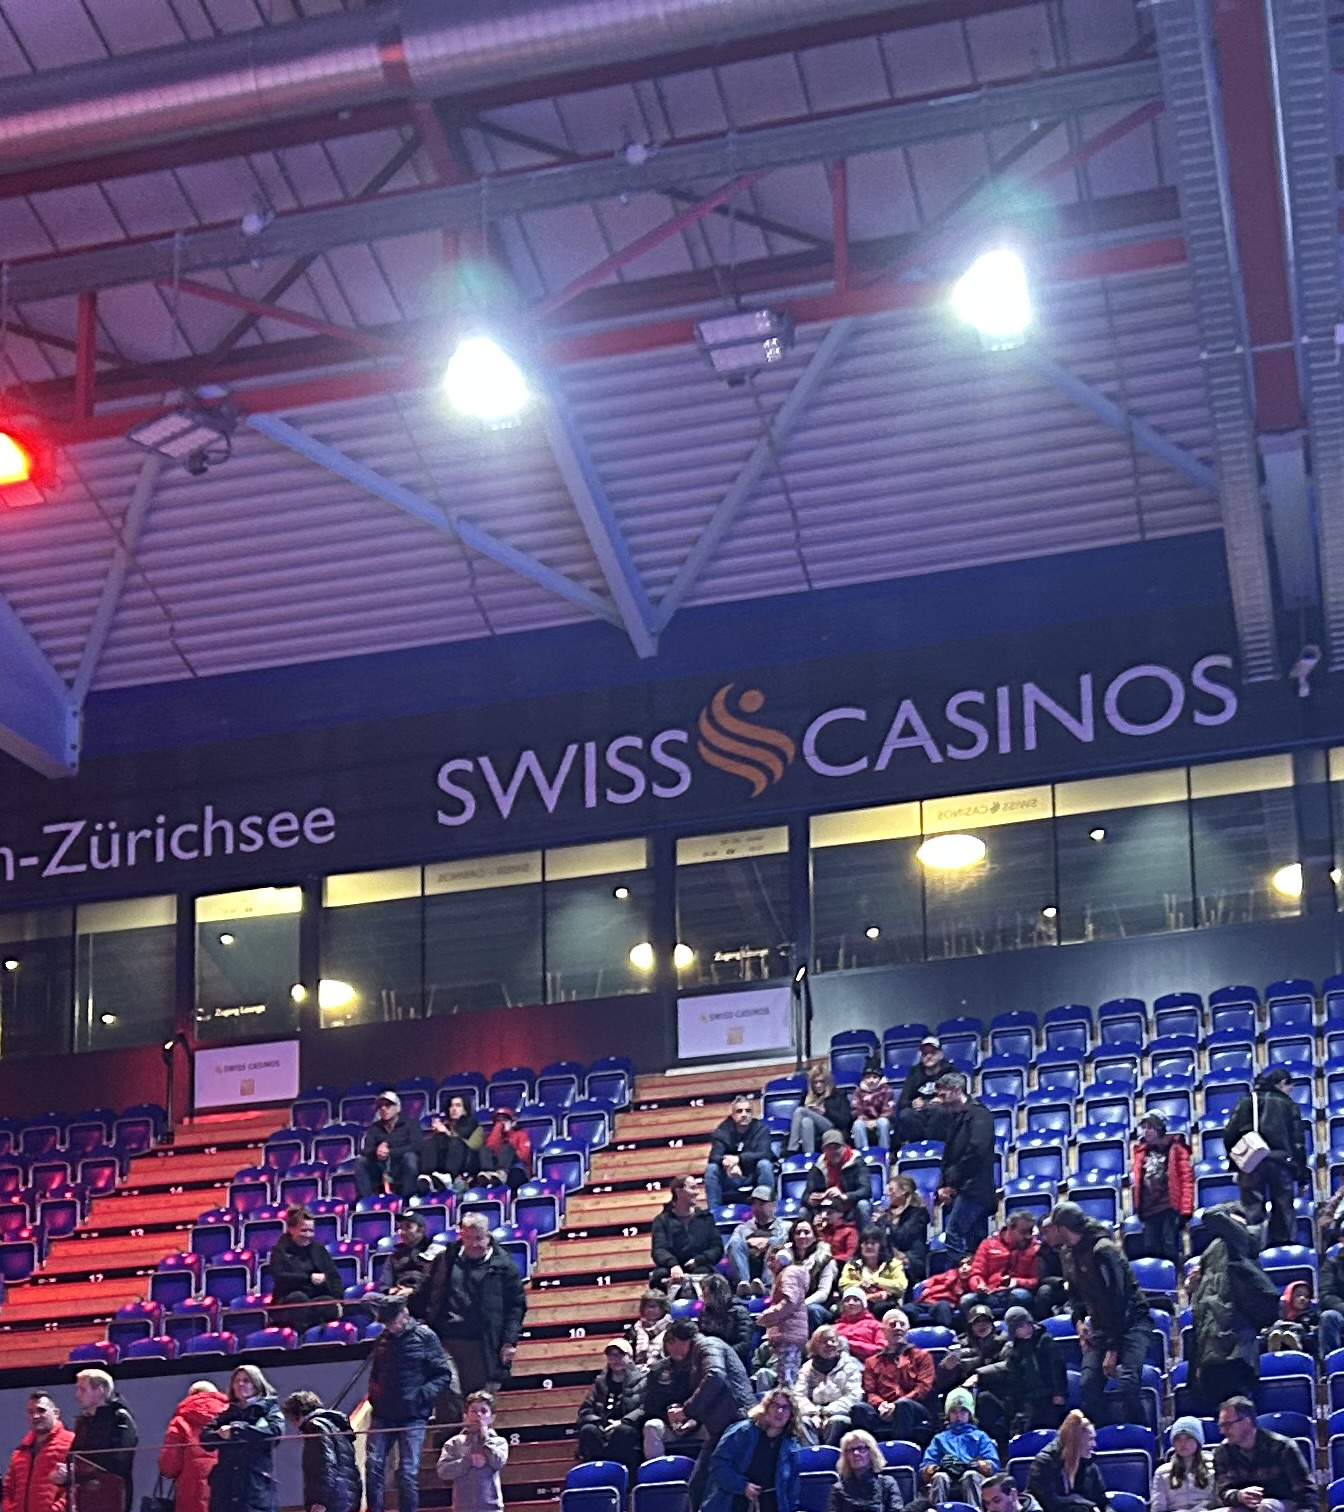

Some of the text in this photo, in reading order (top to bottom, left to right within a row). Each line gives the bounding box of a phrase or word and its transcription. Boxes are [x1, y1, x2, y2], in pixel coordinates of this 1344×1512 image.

[435, 654, 1240, 827] SWISS CASINOS
[595, 1275, 612, 1286] 11
[568, 1327, 586, 1339] 10
[542, 1379, 553, 1391] 9
